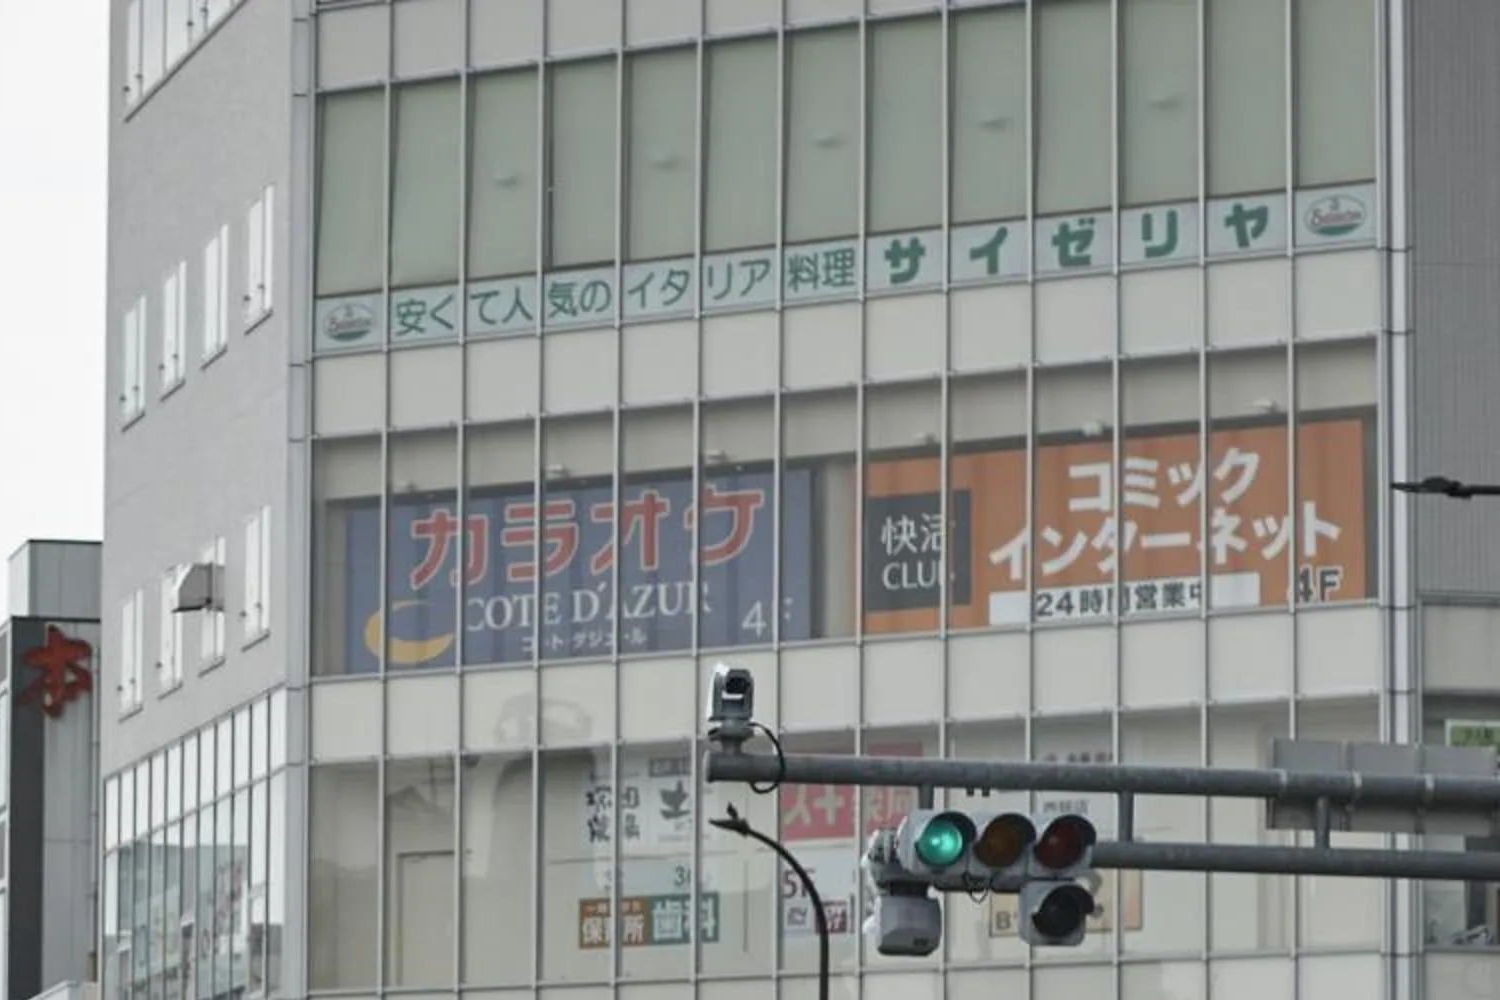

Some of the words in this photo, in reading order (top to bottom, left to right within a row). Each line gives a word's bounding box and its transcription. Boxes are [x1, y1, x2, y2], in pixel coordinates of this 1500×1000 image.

[396, 246, 857, 336] 安くて人気のイタリア料理
[883, 203, 1269, 285] サイゼリヤ
[1068, 446, 1260, 514] コミック
[409, 484, 765, 590] カラオケ
[989, 501, 1341, 580] インターネット
